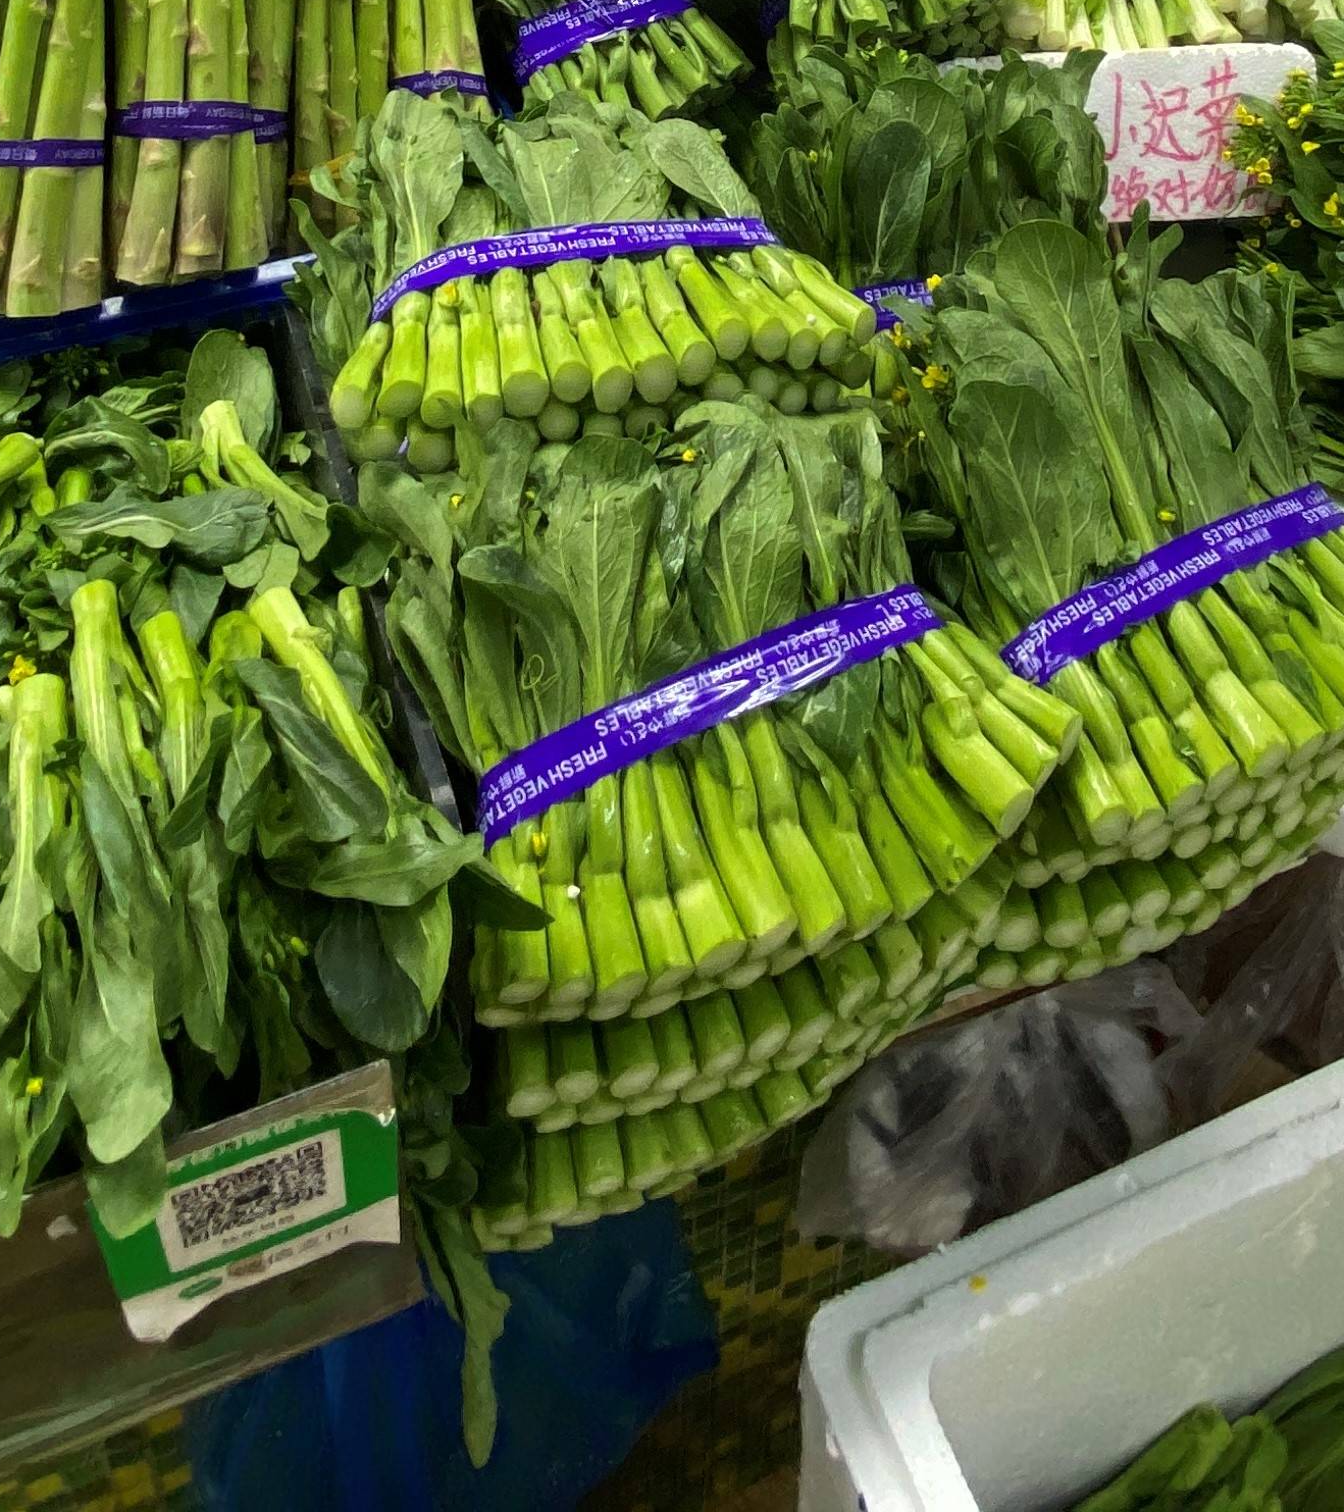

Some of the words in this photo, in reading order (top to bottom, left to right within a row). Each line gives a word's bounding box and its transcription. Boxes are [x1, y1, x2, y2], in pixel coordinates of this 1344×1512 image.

[466, 232, 567, 274] VEGETABLES
[1200, 503, 1276, 548] VEGETABLES
[1088, 566, 1182, 628] VEGETABLES
[753, 625, 860, 691] VEGETABLES
[543, 739, 609, 784] FRESH
